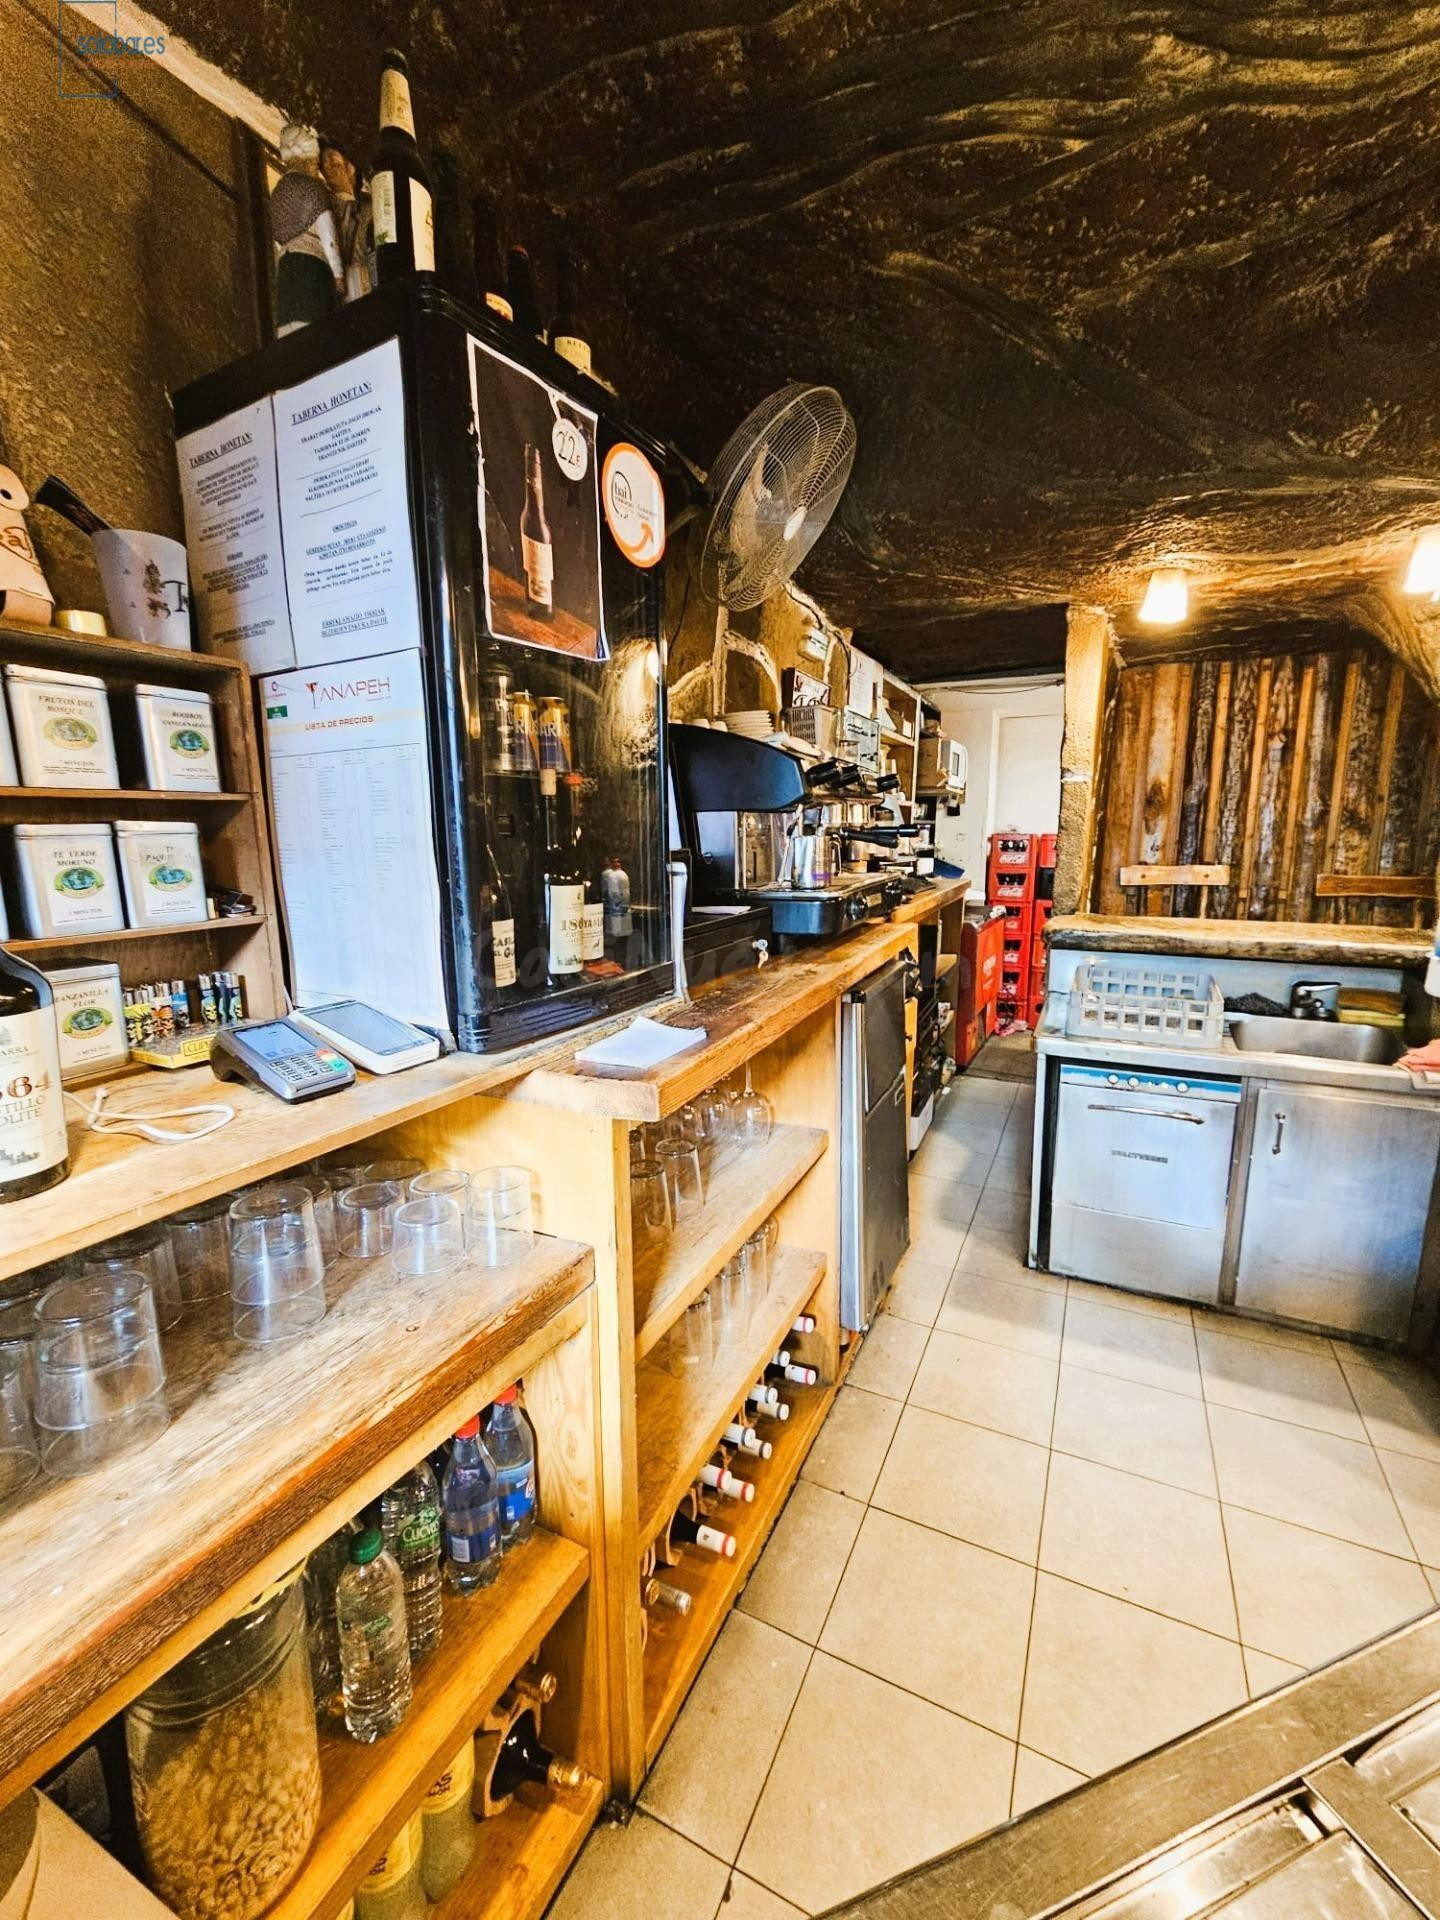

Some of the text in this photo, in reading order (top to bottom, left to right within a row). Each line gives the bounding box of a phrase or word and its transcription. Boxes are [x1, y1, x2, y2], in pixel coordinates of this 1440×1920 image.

[291, 402, 328, 424] TABERNA
[189, 448, 219, 469] TABERNA
[38, 695, 95, 708] FRUTOS DEL
[305, 715, 375, 731] LISTA DE PRECIOS
